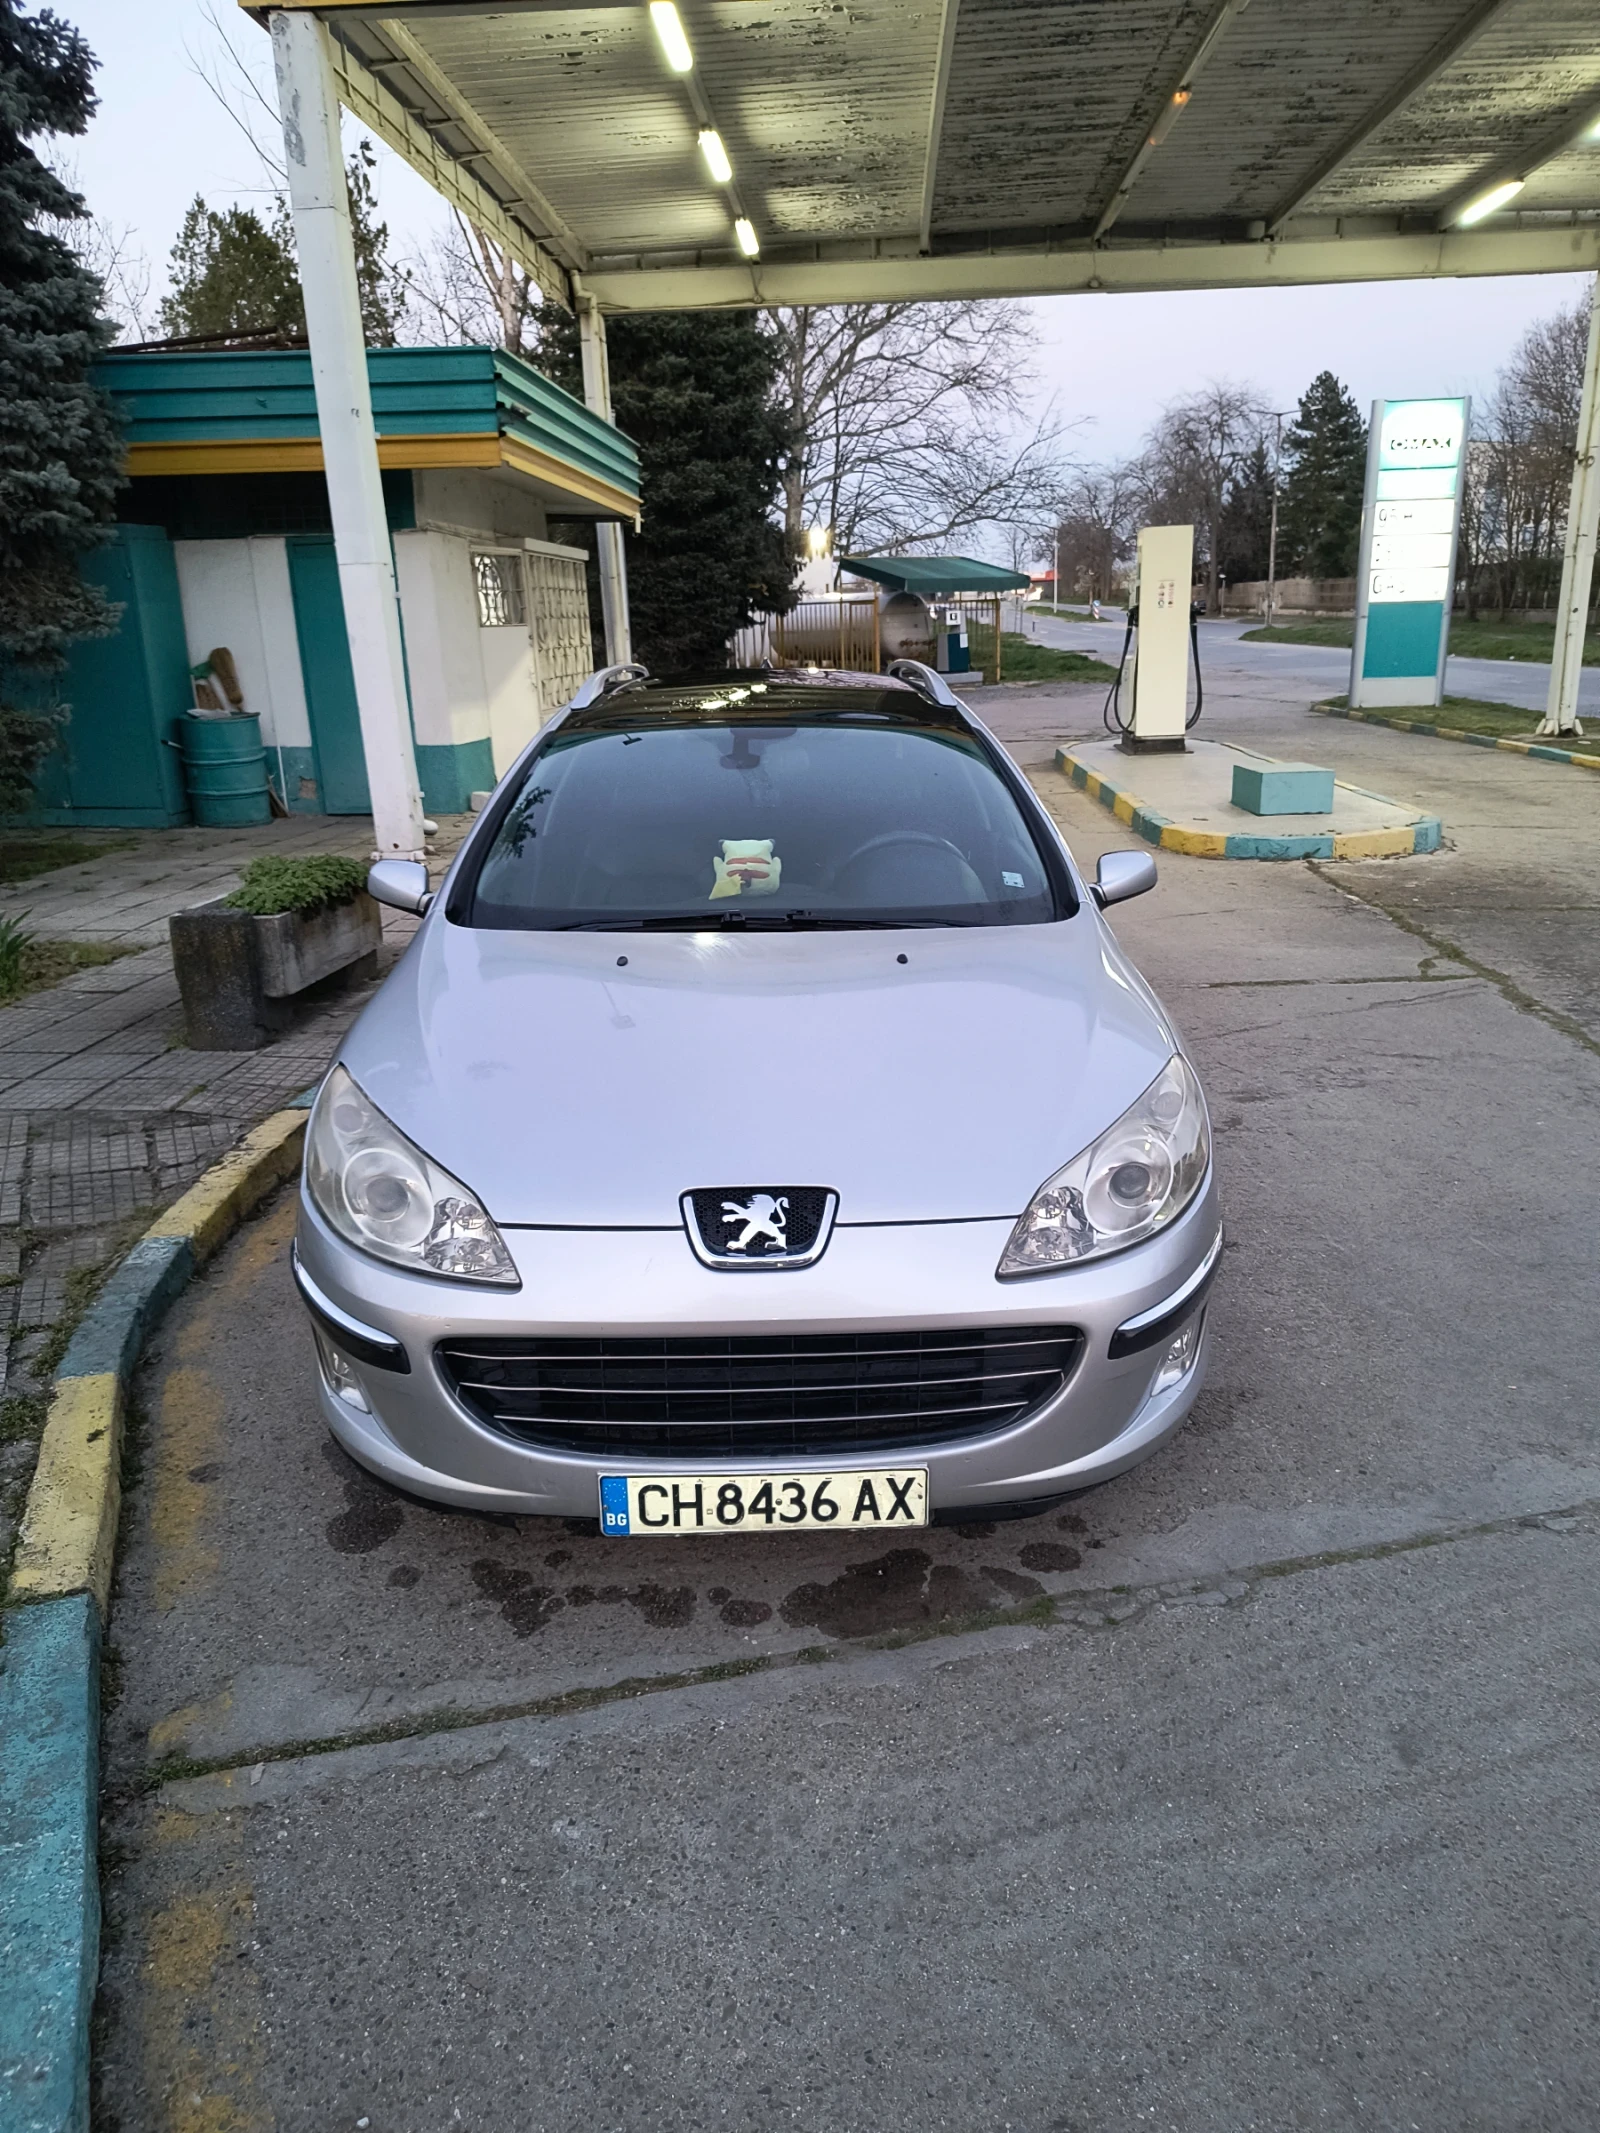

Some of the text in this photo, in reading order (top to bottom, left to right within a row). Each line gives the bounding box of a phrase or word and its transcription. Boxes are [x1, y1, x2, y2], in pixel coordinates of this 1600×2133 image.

[638, 1477, 916, 1527] CH 8436 AX
[606, 1512, 627, 1526] BG
